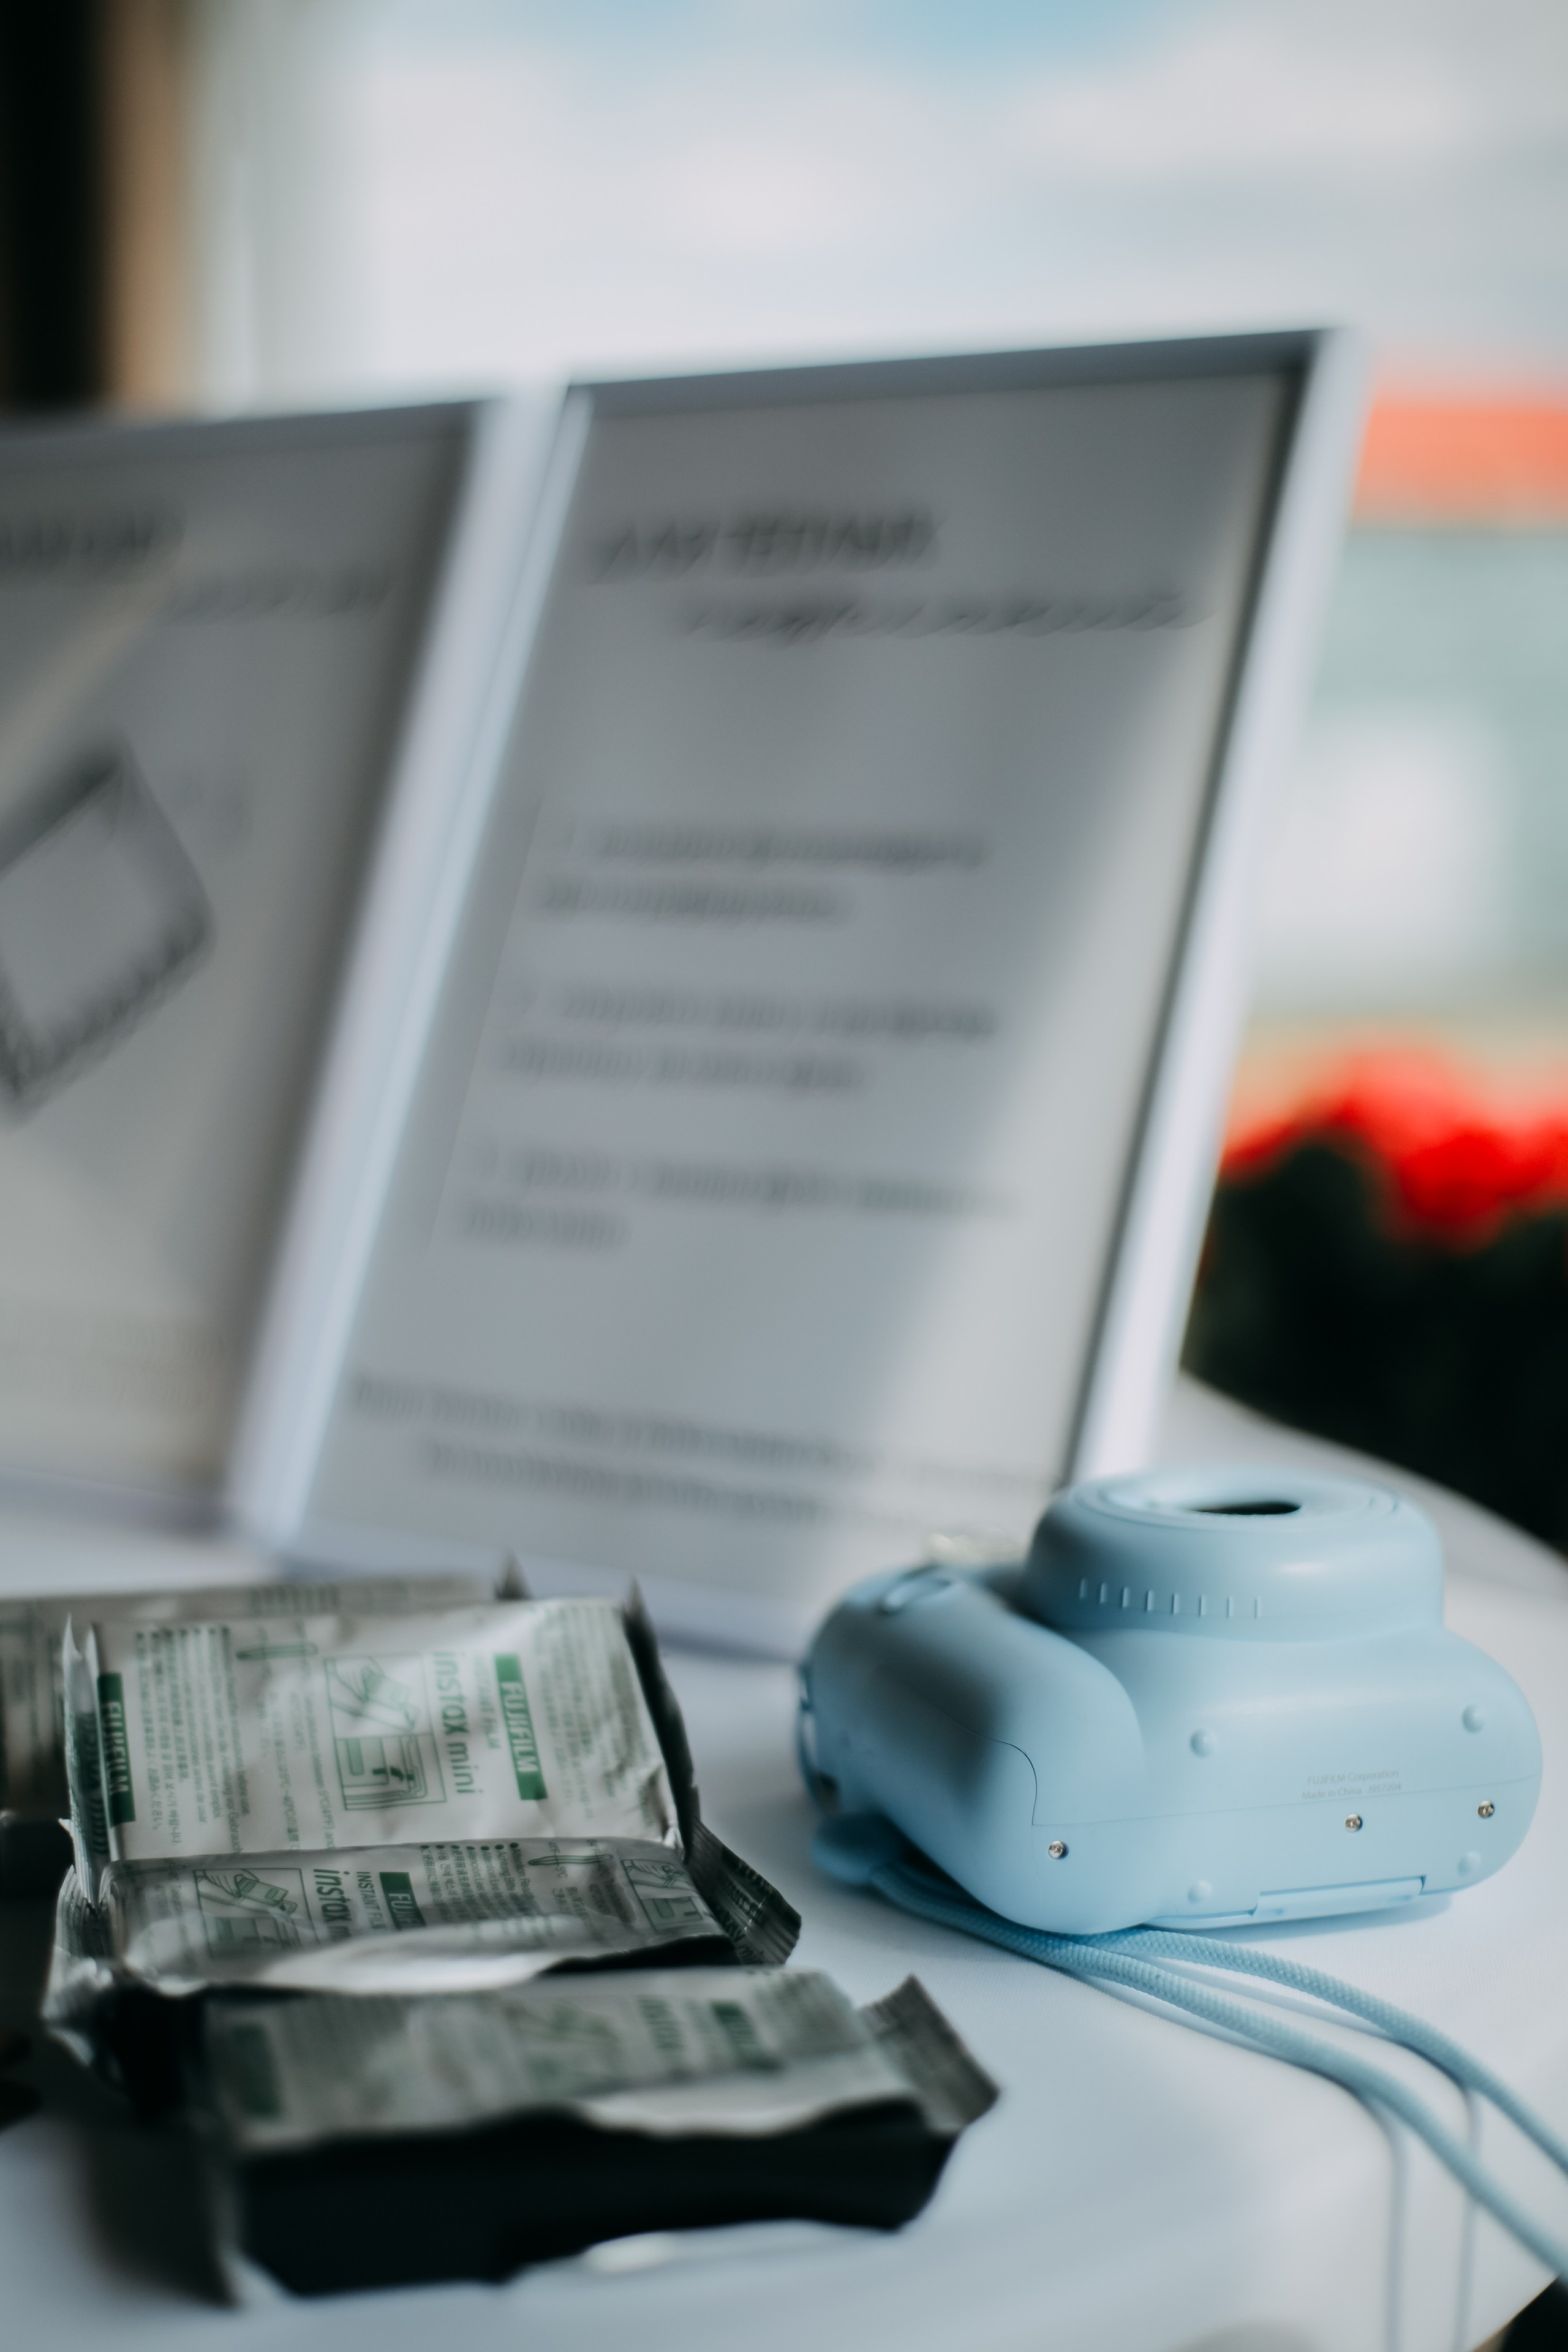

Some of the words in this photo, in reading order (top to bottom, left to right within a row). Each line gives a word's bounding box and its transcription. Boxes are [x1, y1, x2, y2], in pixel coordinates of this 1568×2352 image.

[434, 1651, 469, 1735] instax
[500, 1682, 538, 1772] FUJIFILM
[447, 1742, 483, 1794] mini
[1308, 1773, 1346, 1785] FUJIFILM
[1348, 1770, 1399, 1782] Corporation
[1302, 1790, 1326, 1800] Made
[314, 1869, 353, 1923] instax
[356, 1871, 380, 1910] INSTANT
[505, 1878, 516, 1891] Bitte
